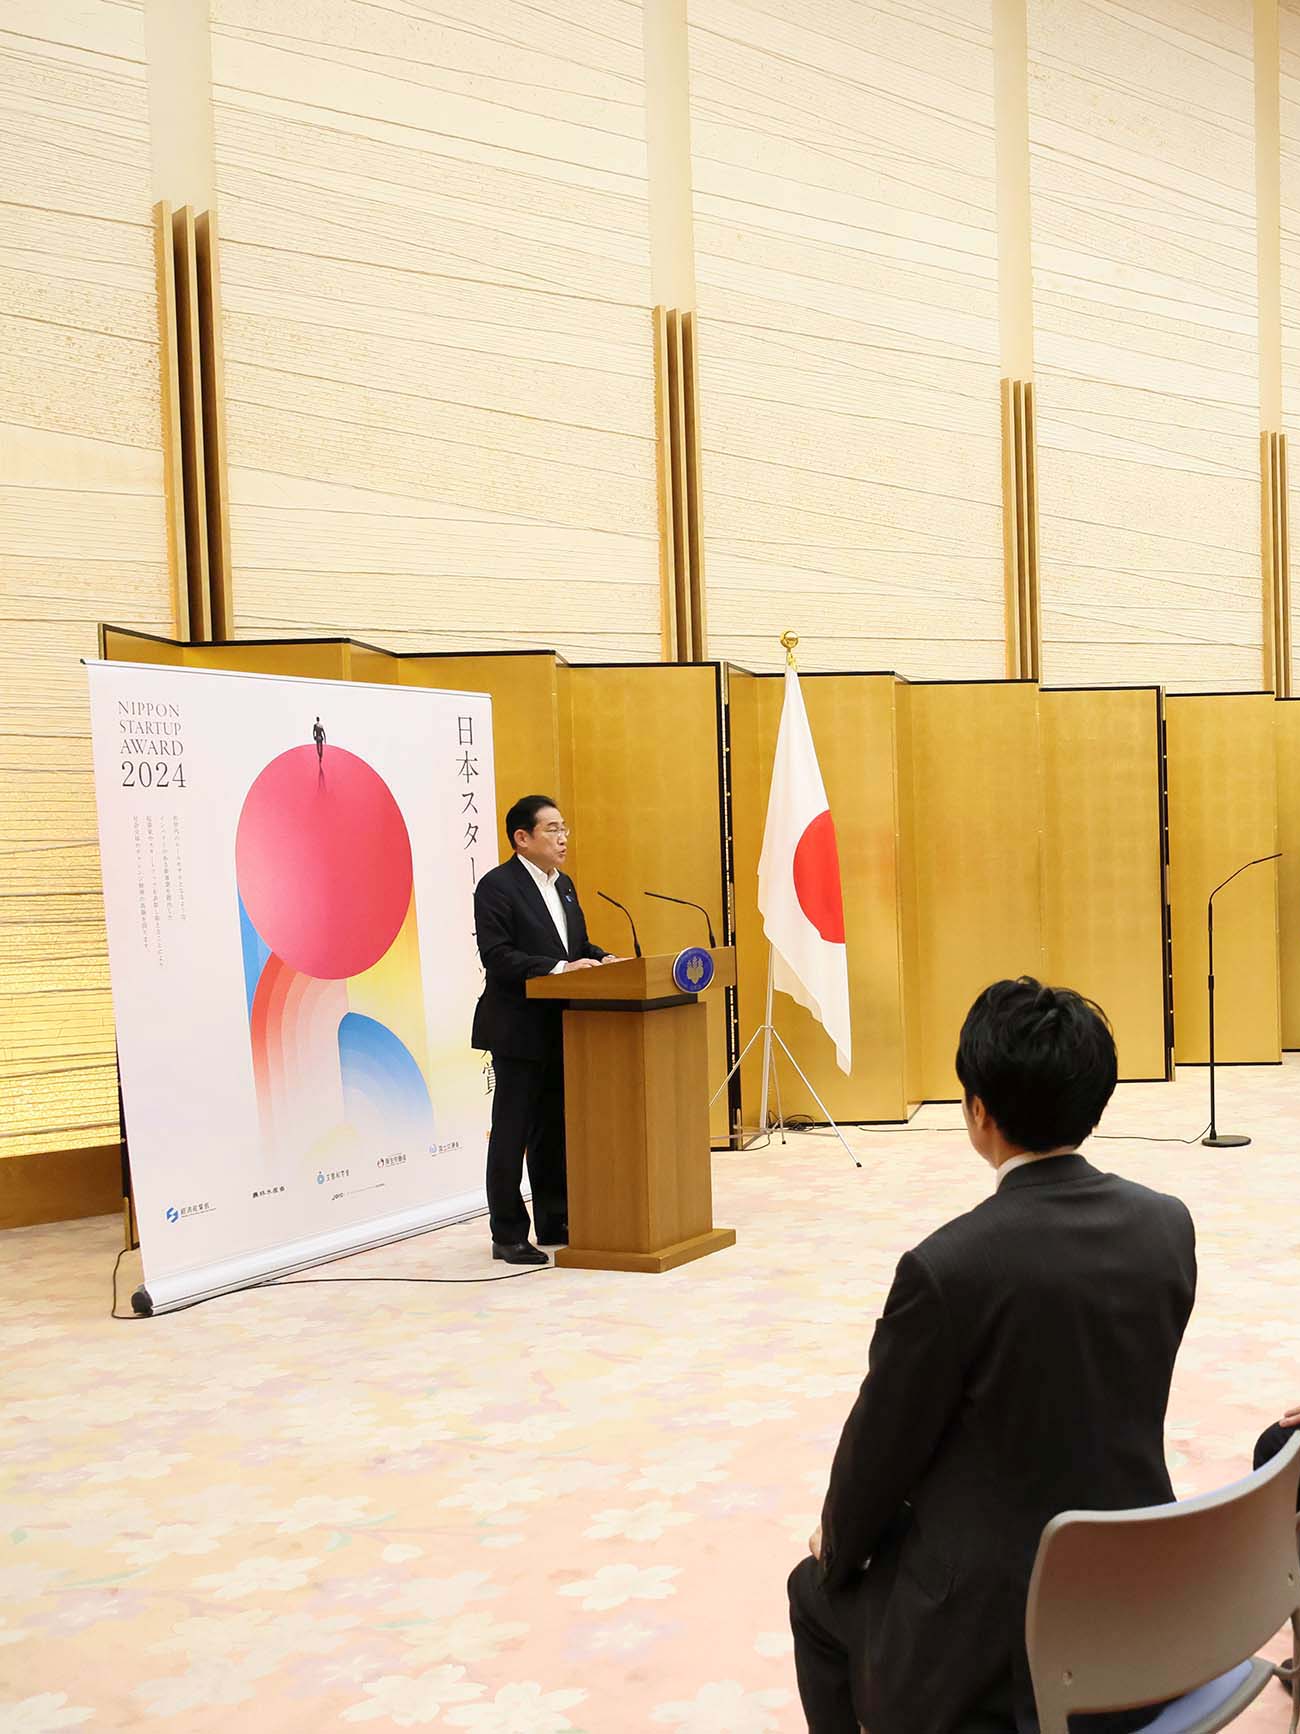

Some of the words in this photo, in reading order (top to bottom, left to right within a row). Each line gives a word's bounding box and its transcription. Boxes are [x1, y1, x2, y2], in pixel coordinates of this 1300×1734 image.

[118, 701, 180, 717] NIPPON
[119, 720, 182, 736] STARTUP
[120, 739, 184, 756] AWARD
[121, 761, 187, 788] 2024
